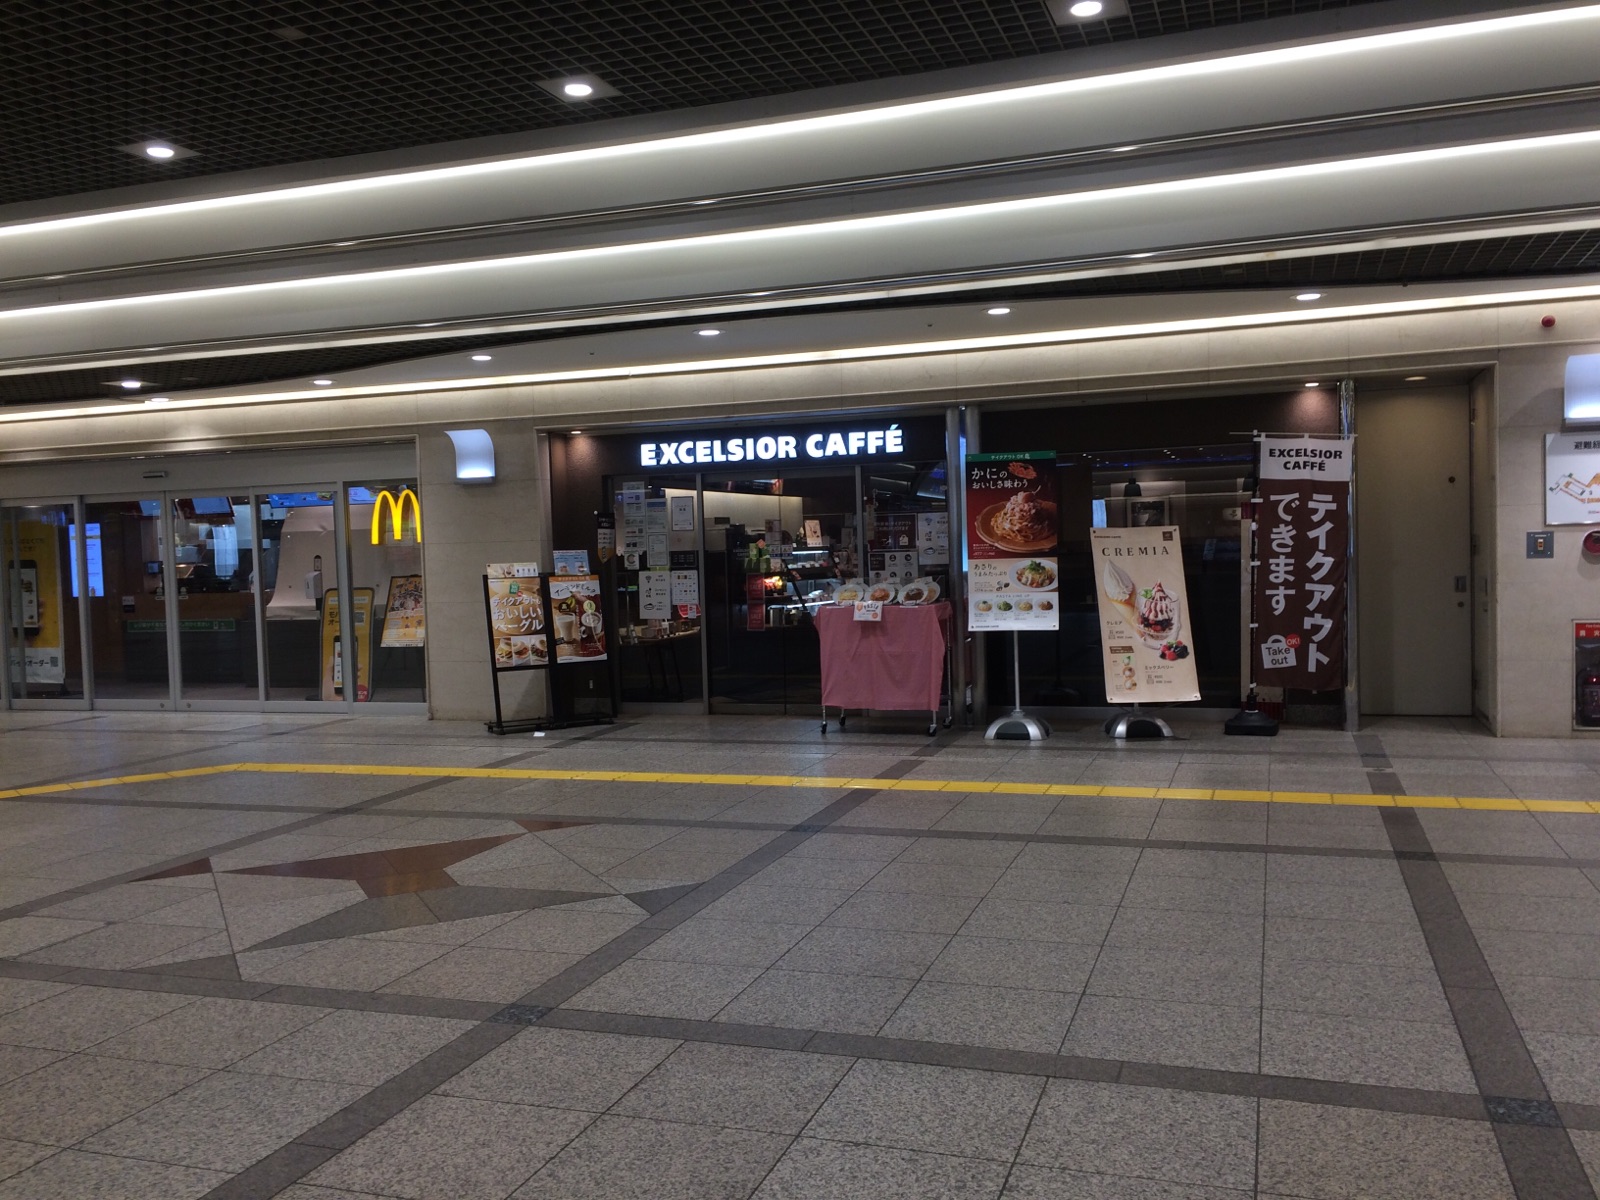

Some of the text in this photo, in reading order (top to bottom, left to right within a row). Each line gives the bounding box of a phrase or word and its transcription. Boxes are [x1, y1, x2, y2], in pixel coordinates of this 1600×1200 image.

[640, 424, 905, 468] EXCELSIOR CAFFÉ
[1268, 447, 1343, 460] EXCELSIOR
[1282, 460, 1327, 472] CAFFÉ
[971, 467, 1008, 480] かにの
[971, 478, 1029, 489] おいしさ味わう
[1101, 546, 1170, 557] CREMIA
[1265, 491, 1300, 616] できます
[1303, 493, 1338, 674] テイクアウト
[492, 596, 541, 608] テイクアウトも
[863, 602, 880, 610] PASTA
[492, 605, 543, 621] おいしい
[495, 618, 544, 633] ベーグル
[1286, 637, 1301, 646] OK!
[1265, 645, 1292, 656] Take
[1270, 656, 1289, 666] out
